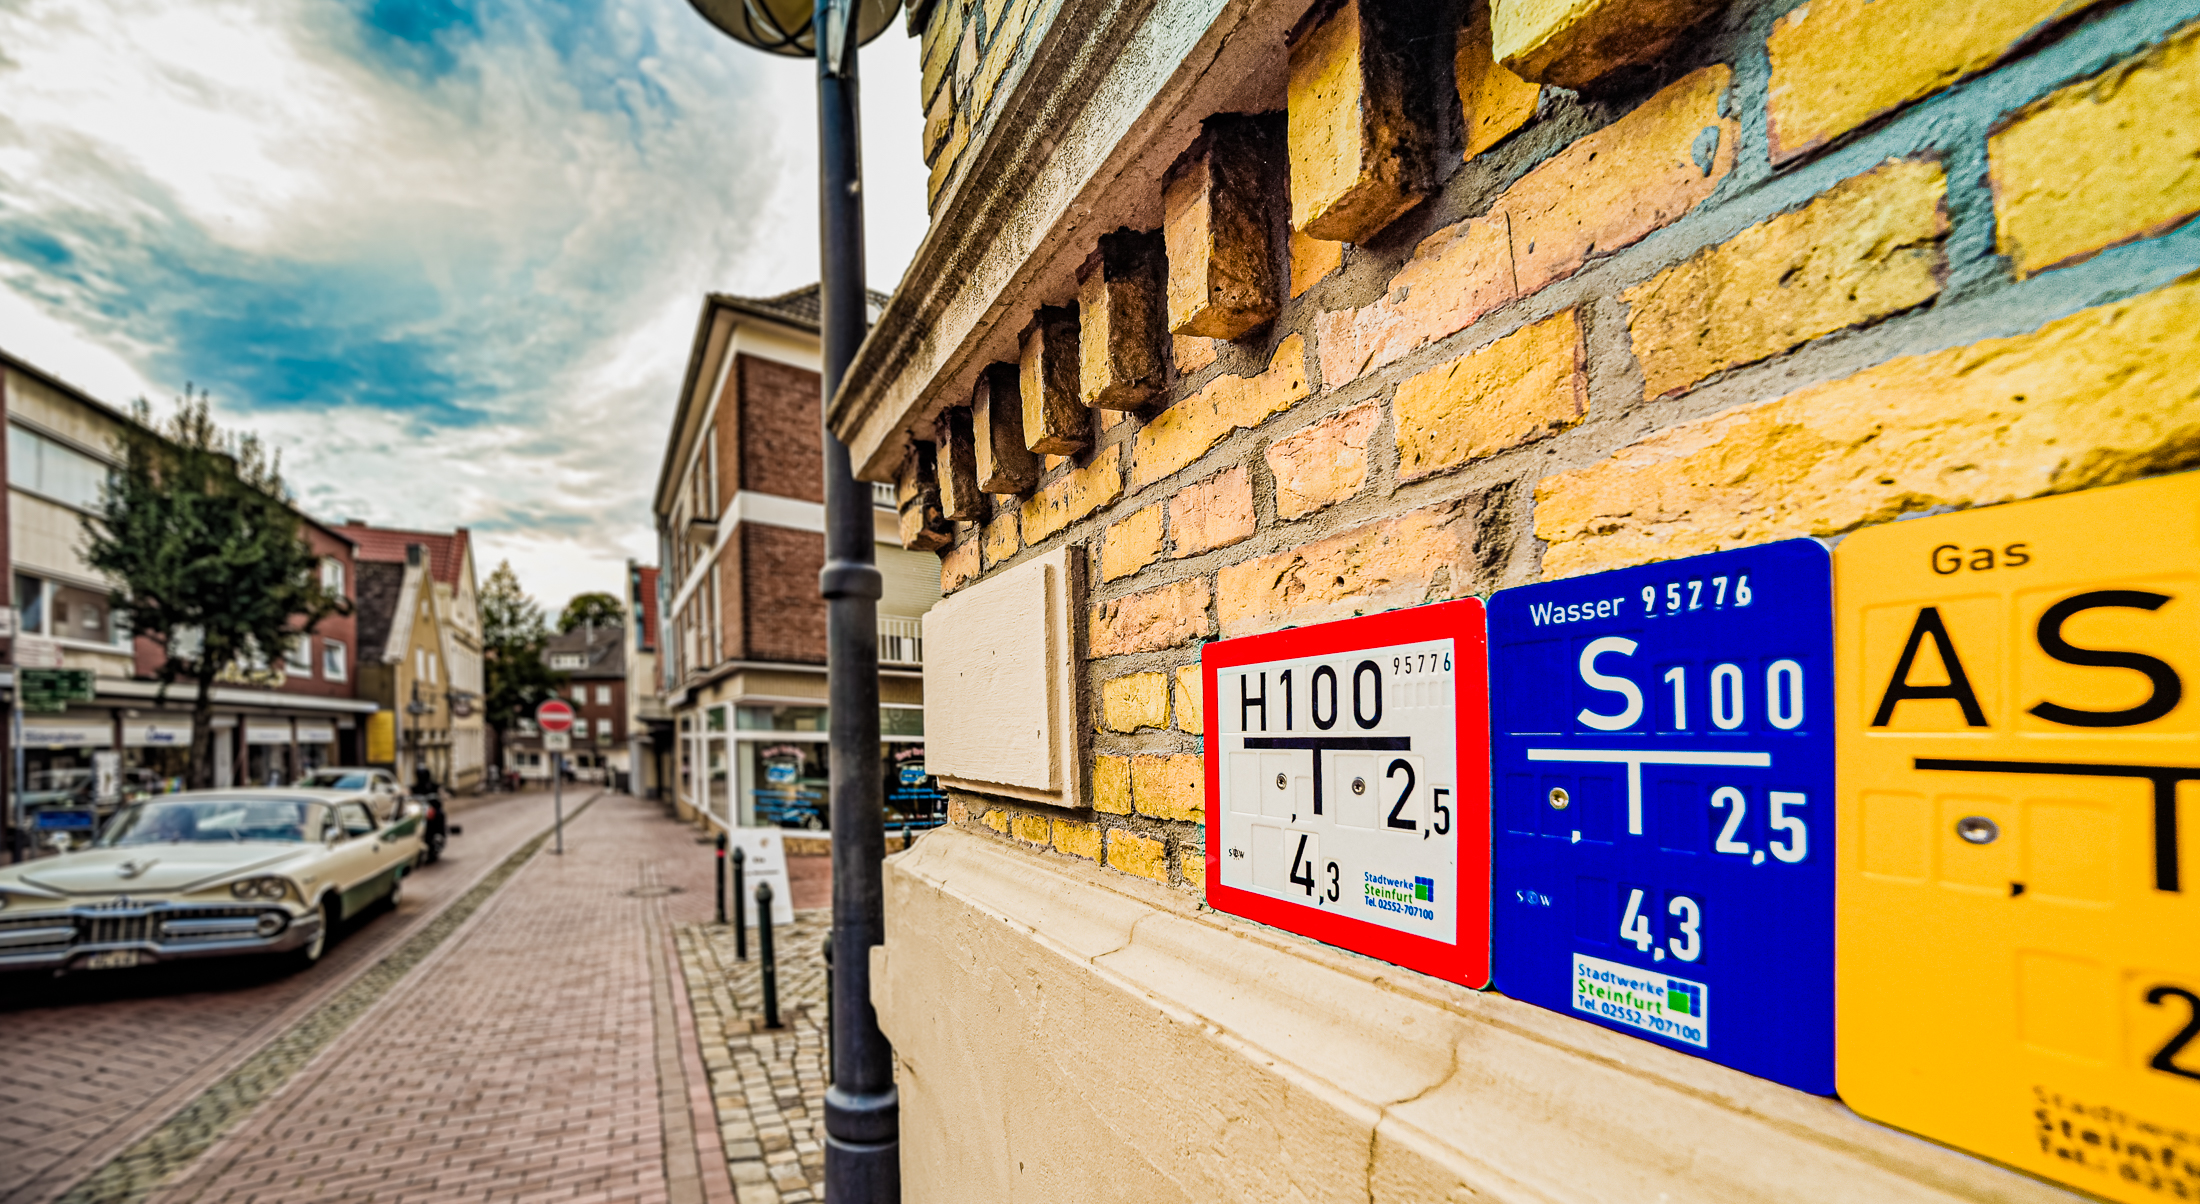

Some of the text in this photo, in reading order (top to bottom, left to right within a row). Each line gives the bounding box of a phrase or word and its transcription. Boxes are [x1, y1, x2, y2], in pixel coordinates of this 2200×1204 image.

[1931, 543, 2031, 575] Gas
[1529, 575, 1752, 627] Wasser 95776
[1240, 652, 1452, 731] H100 95776
[1664, 659, 1804, 731] 100
[1290, 834, 1340, 905] 4,3
[1364, 871, 1414, 891] Stadtwerke
[1364, 883, 1413, 904] Steinfurt
[1378, 898, 1434, 921] 02552-707100
[1619, 888, 1701, 962] 4,3
[1578, 963, 1664, 997] Stadtwerke
[1578, 978, 1663, 1015] Steinfurt
[1601, 1002, 1701, 1042] 02552-707100
